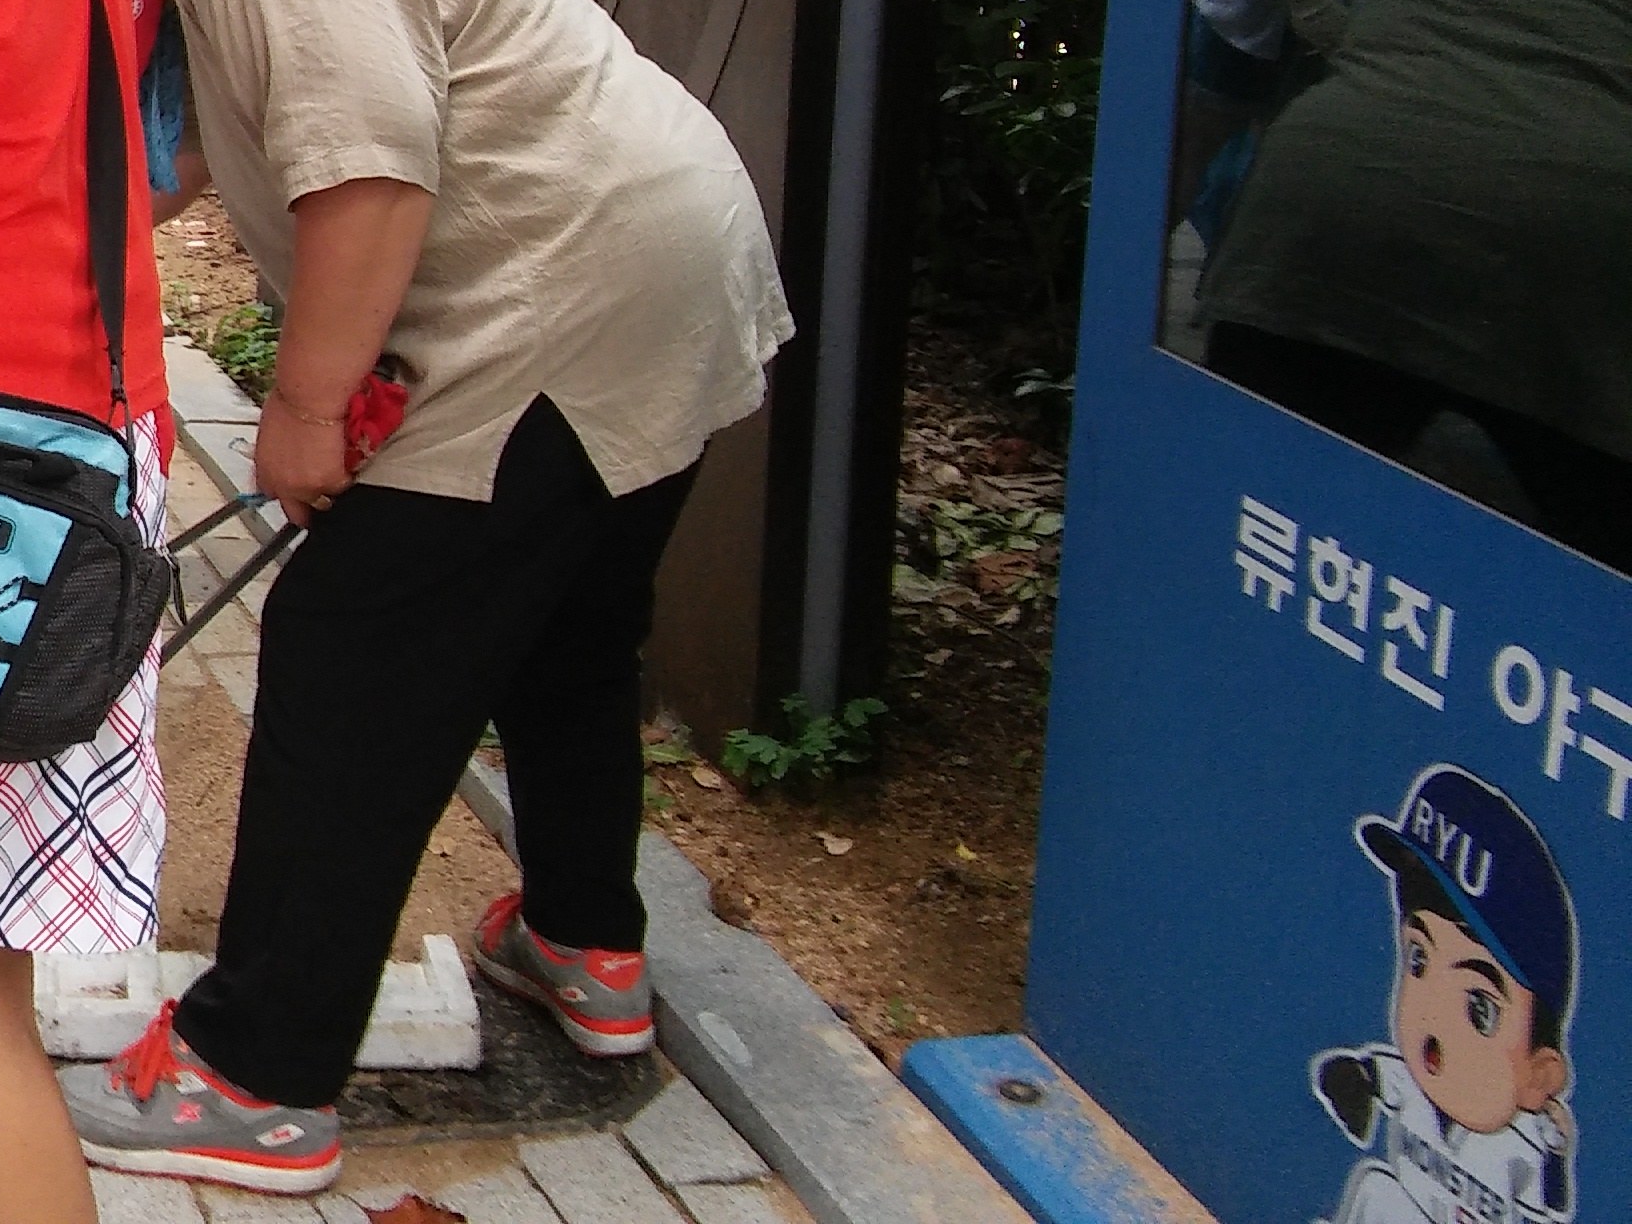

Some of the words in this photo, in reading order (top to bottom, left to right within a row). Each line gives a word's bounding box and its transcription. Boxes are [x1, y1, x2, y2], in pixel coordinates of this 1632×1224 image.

[1235, 495, 1456, 711] 류현진
[1492, 645, 1632, 821] 야구
[1413, 797, 1494, 897] RYU
